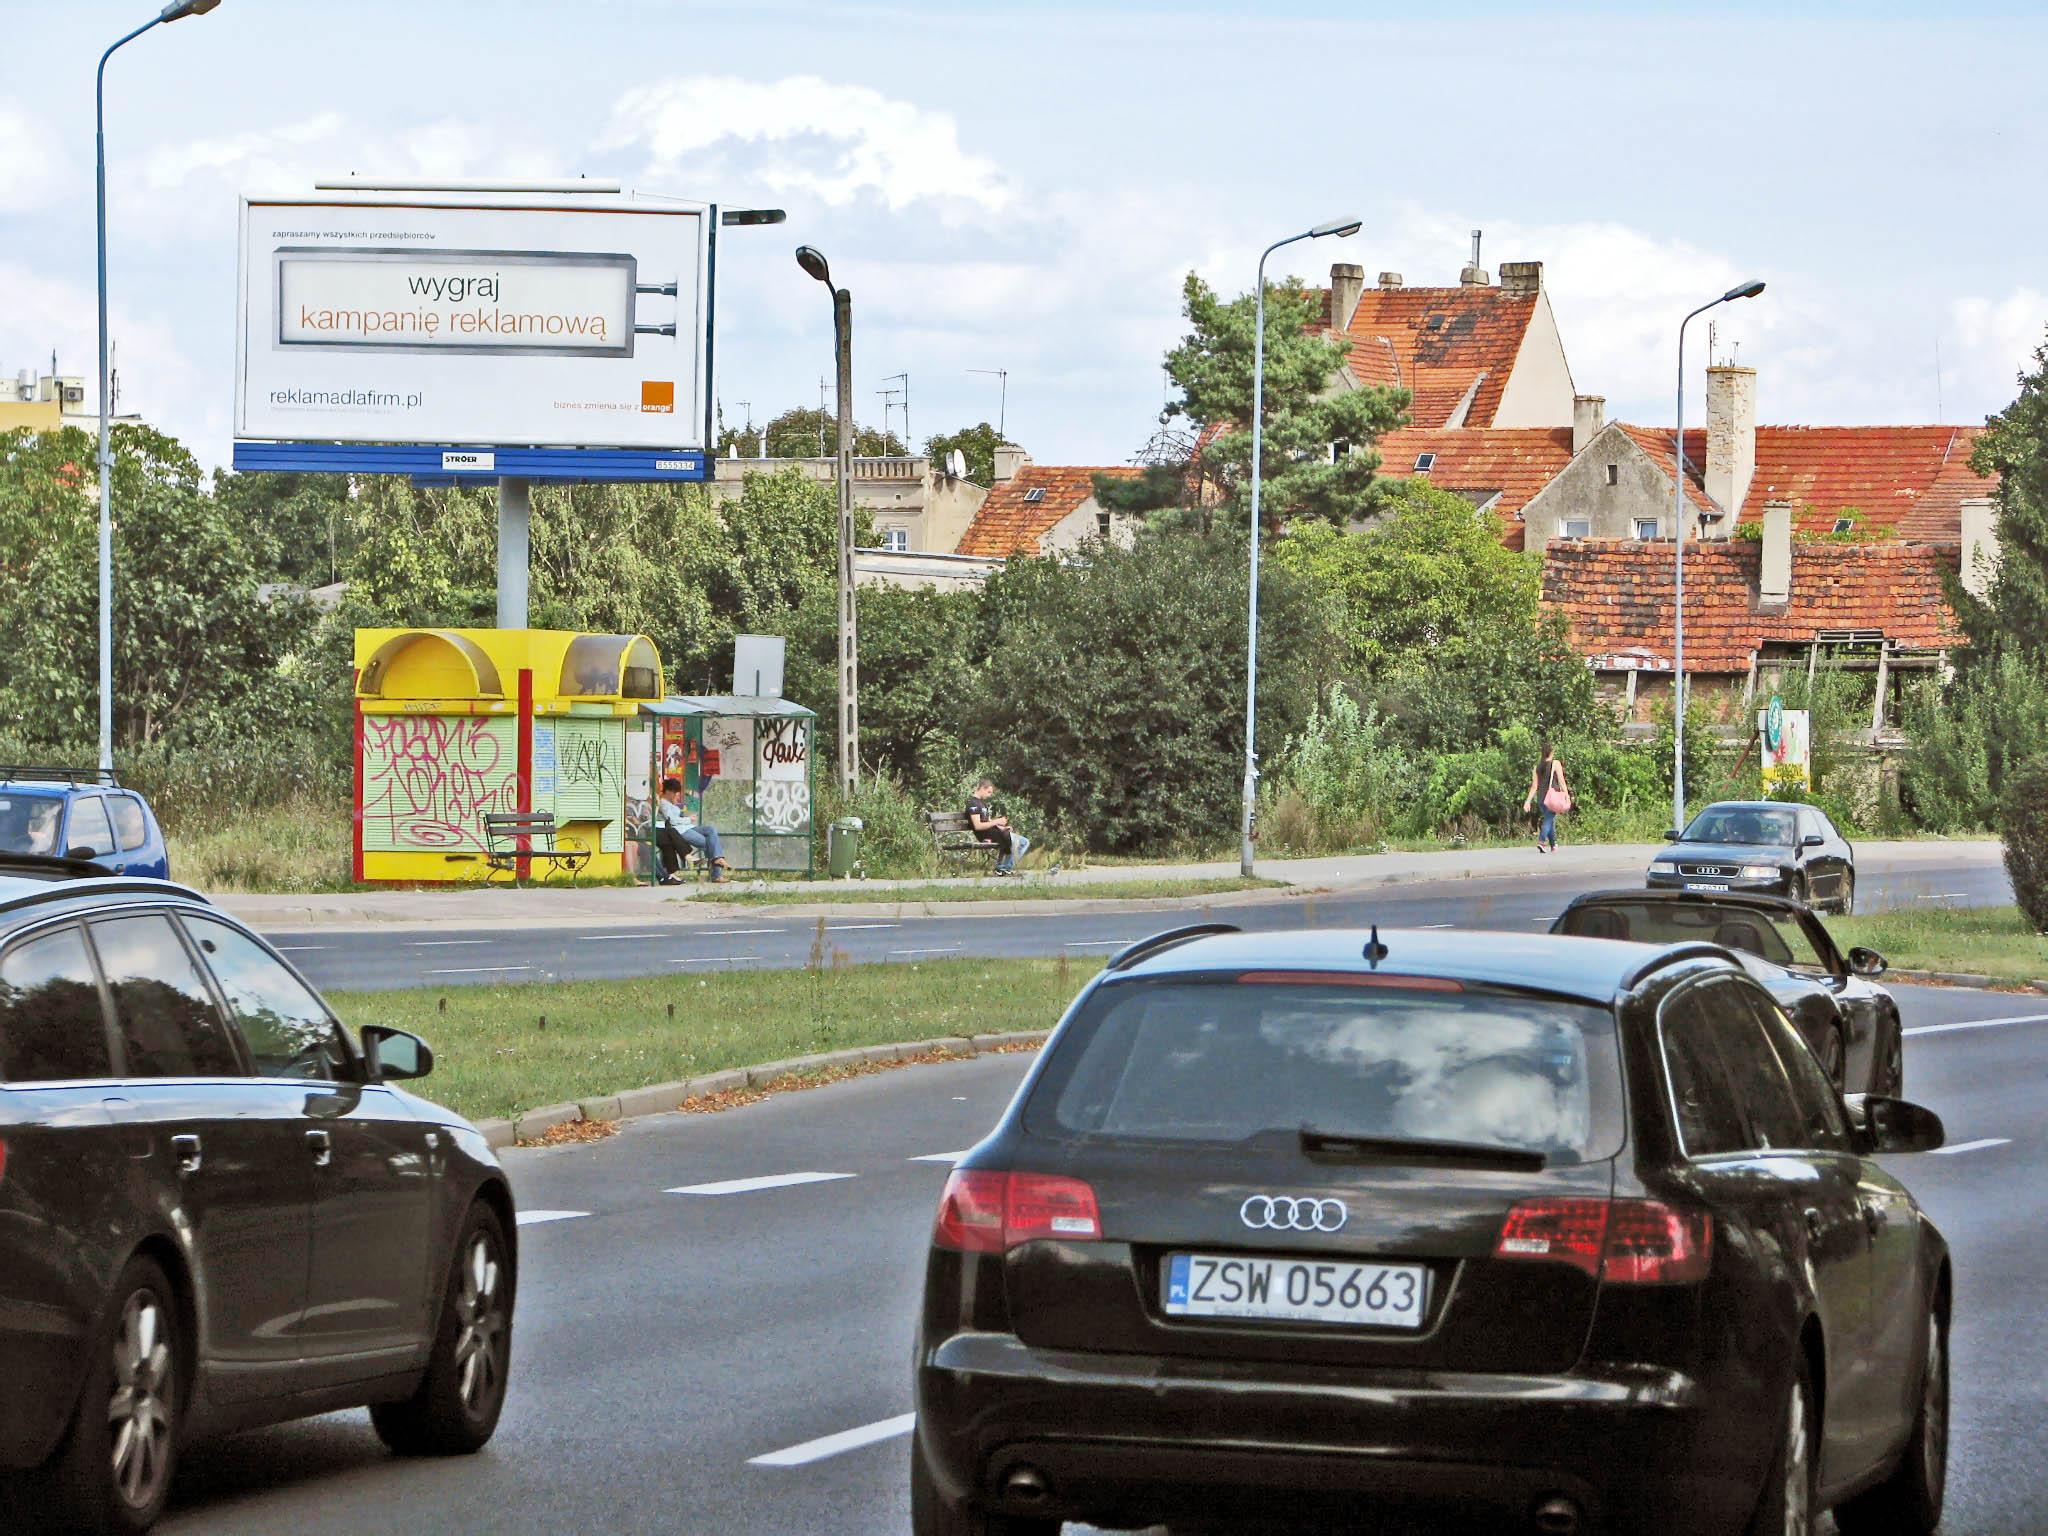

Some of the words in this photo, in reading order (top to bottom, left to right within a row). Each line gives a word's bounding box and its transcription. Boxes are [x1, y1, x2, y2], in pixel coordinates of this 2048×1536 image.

[272, 231, 320, 239] zapraszamy
[322, 231, 368, 240] wszystkich
[408, 272, 500, 302] wygraj
[301, 305, 440, 338] kampanię
[450, 308, 607, 341] reklamową
[270, 388, 422, 409] reklamadlafirm.pl
[553, 401, 582, 409] biznes
[584, 402, 617, 410] zmienia
[642, 403, 673, 413] orange
[1191, 1260, 1272, 1304] ZSW
[1286, 1265, 1416, 1312] 05663
